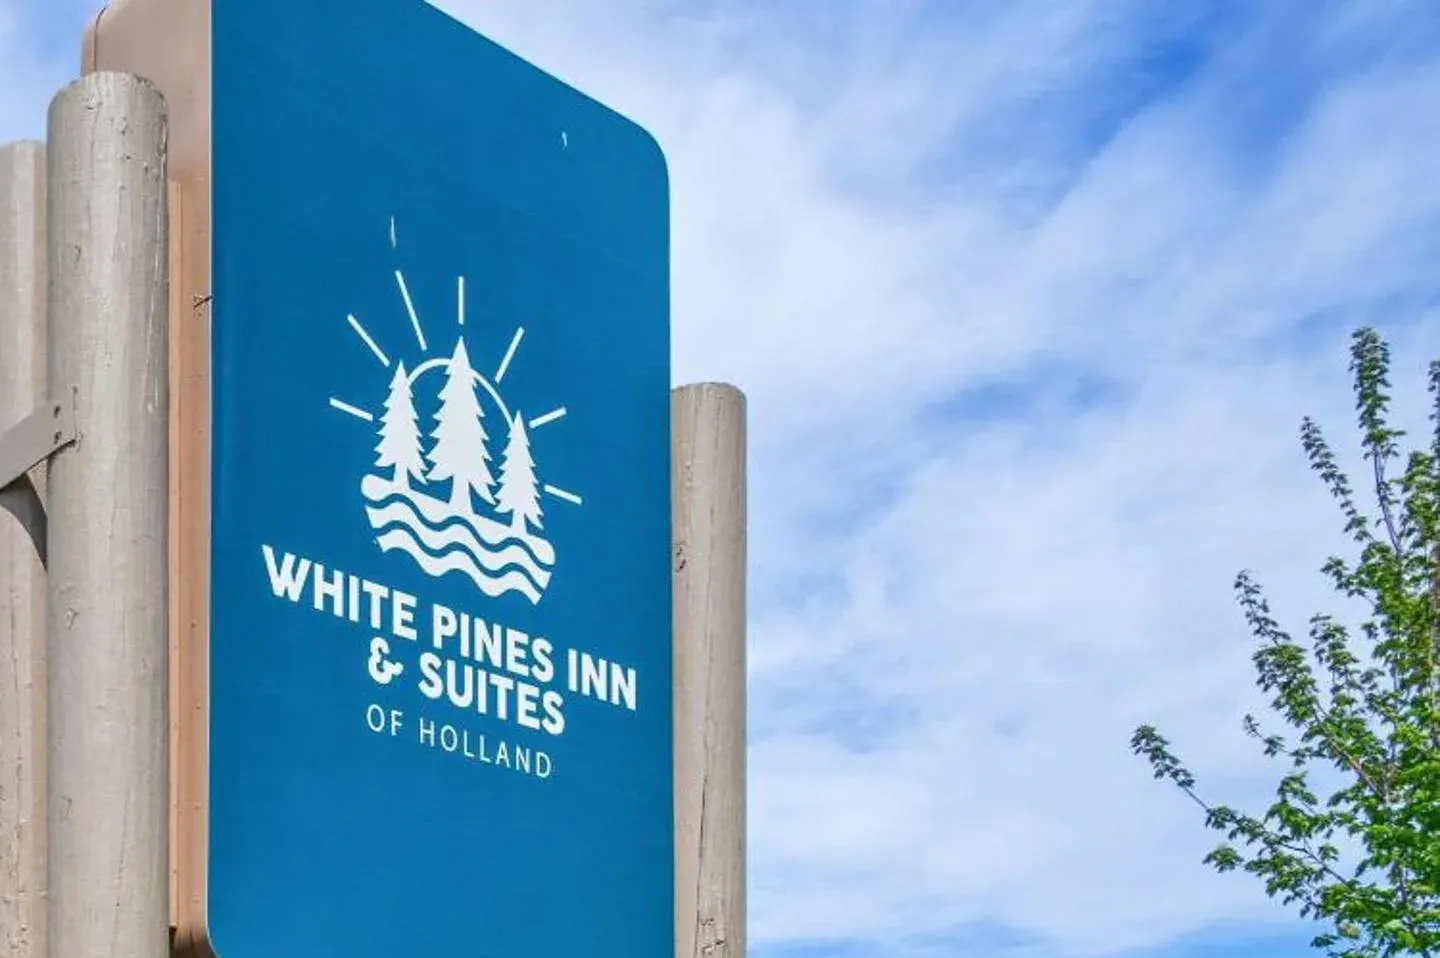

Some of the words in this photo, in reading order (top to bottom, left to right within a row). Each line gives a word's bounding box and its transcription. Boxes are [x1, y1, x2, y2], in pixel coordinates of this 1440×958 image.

[262, 544, 418, 641] WHITE
[432, 603, 554, 683] PINES
[568, 648, 637, 711] INN
[366, 636, 404, 685] &
[418, 652, 565, 735] SUITES
[366, 704, 402, 737] OF
[419, 718, 551, 778] HOLLAND
